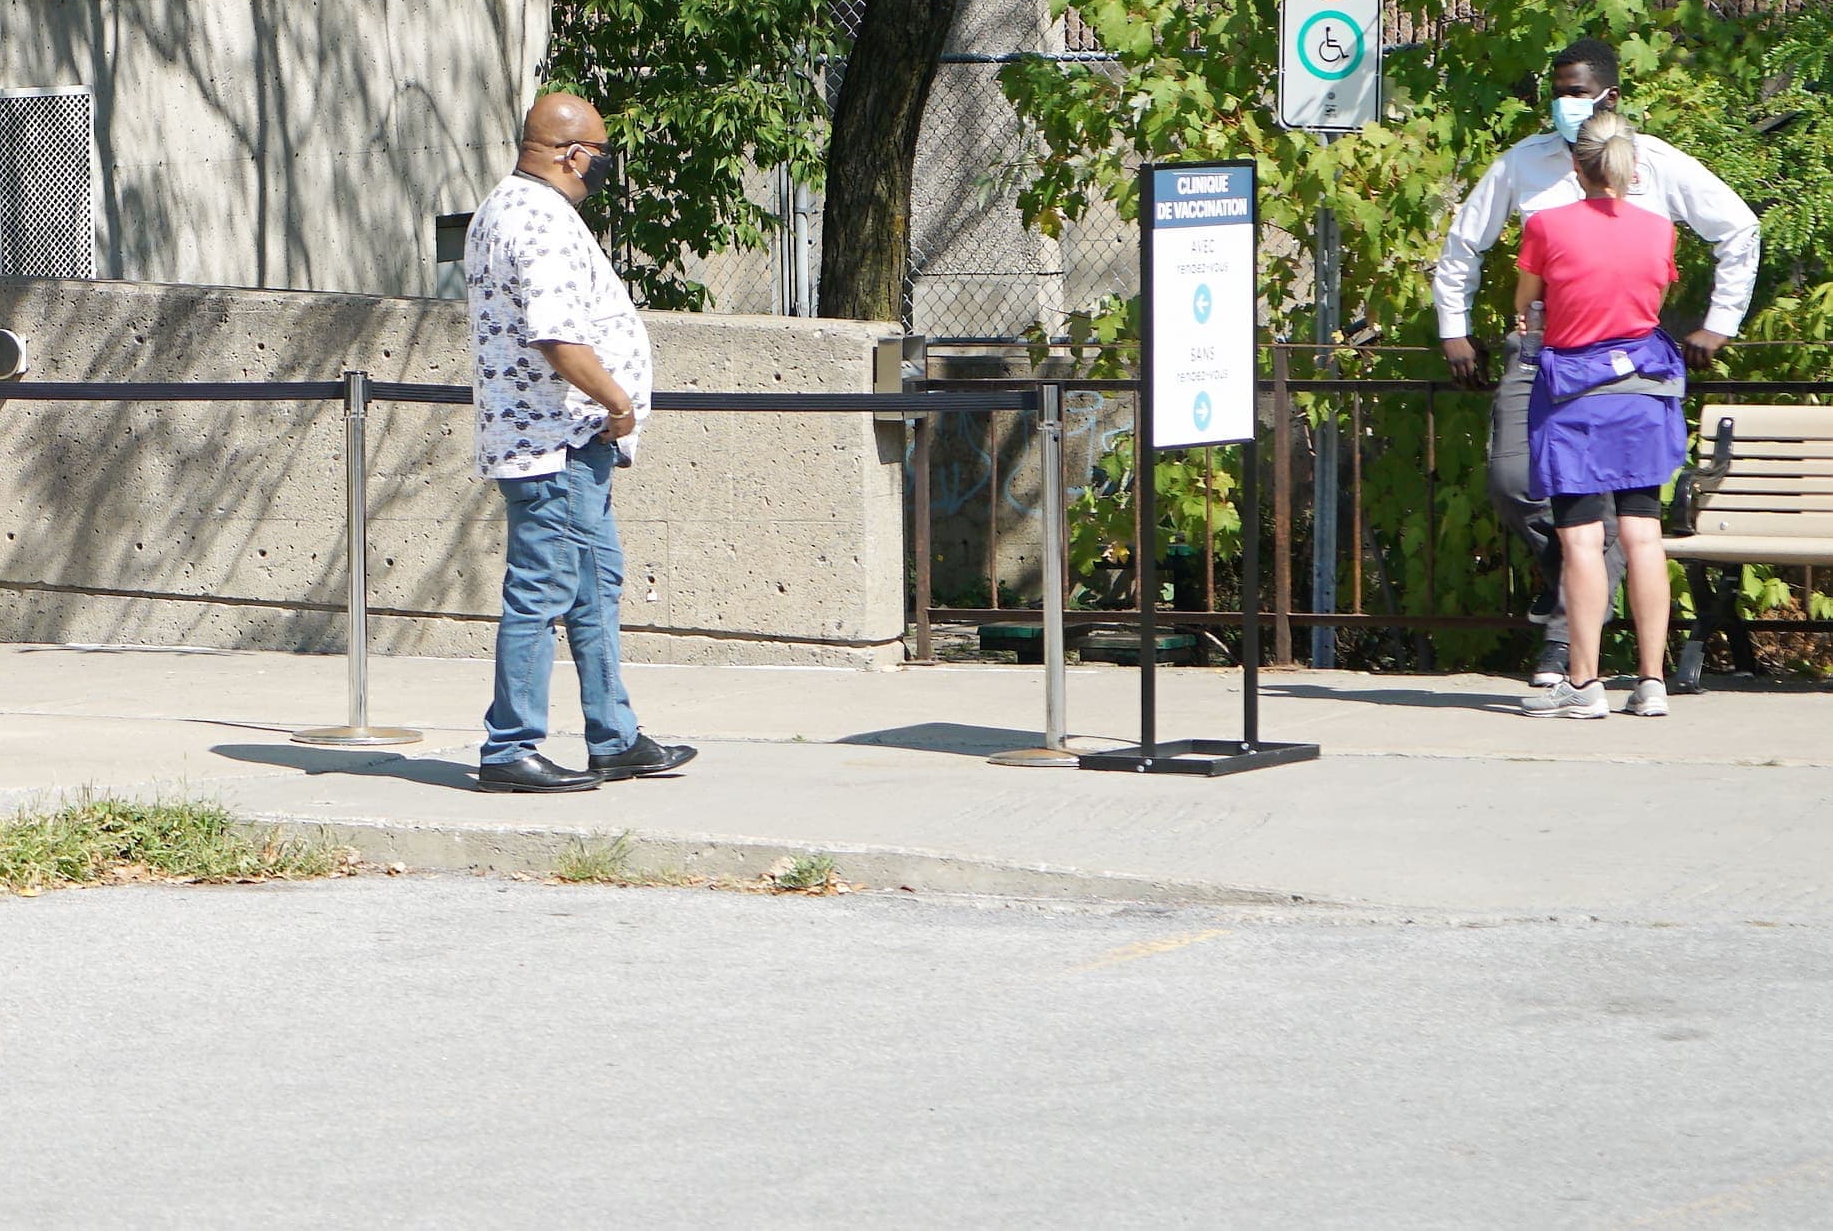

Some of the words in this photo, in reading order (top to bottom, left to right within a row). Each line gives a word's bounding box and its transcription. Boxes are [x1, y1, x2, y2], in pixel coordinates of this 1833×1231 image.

[1177, 175, 1230, 195] CLINIQUE
[1157, 201, 1173, 220] DE
[1173, 198, 1248, 219] VACCINATION
[1191, 238, 1215, 254] AVEC
[1176, 261, 1229, 275] rendez-vous
[1191, 346, 1215, 362] SANS
[1176, 368, 1229, 383] rendez-vous
